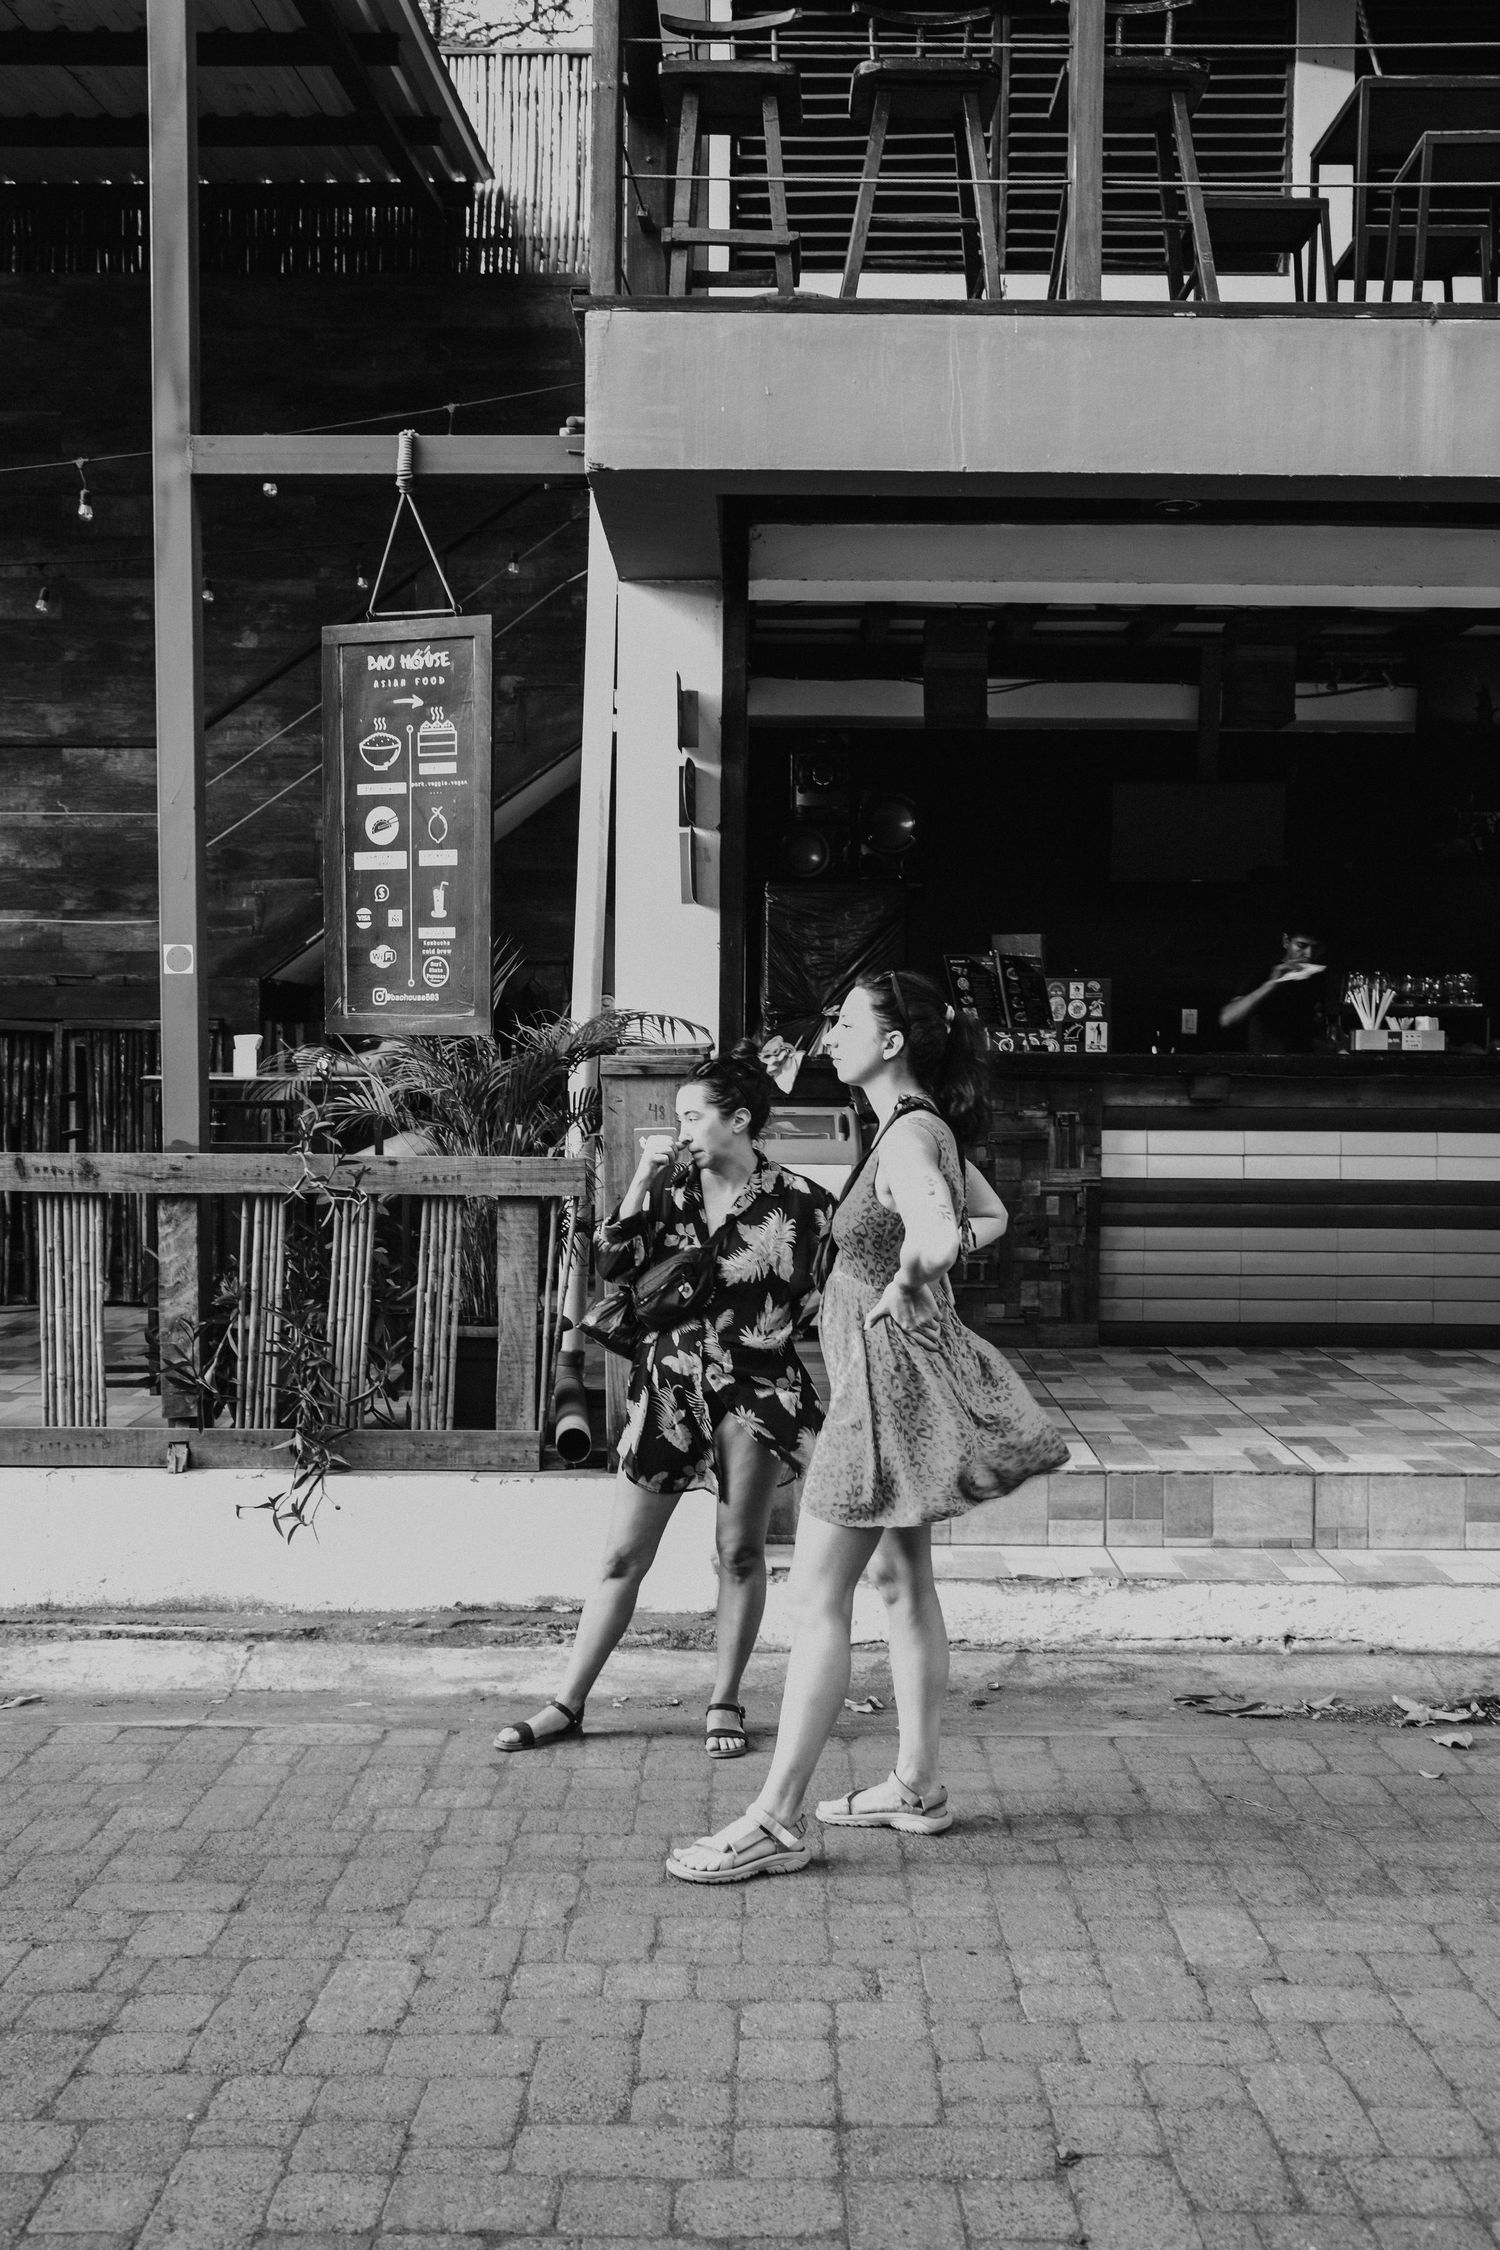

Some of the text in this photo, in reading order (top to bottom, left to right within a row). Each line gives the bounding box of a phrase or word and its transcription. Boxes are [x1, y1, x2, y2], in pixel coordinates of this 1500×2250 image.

[367, 654, 395, 671] BAO
[373, 675, 445, 688] ASIAN FOOD
[648, 1103, 665, 1122] 48
